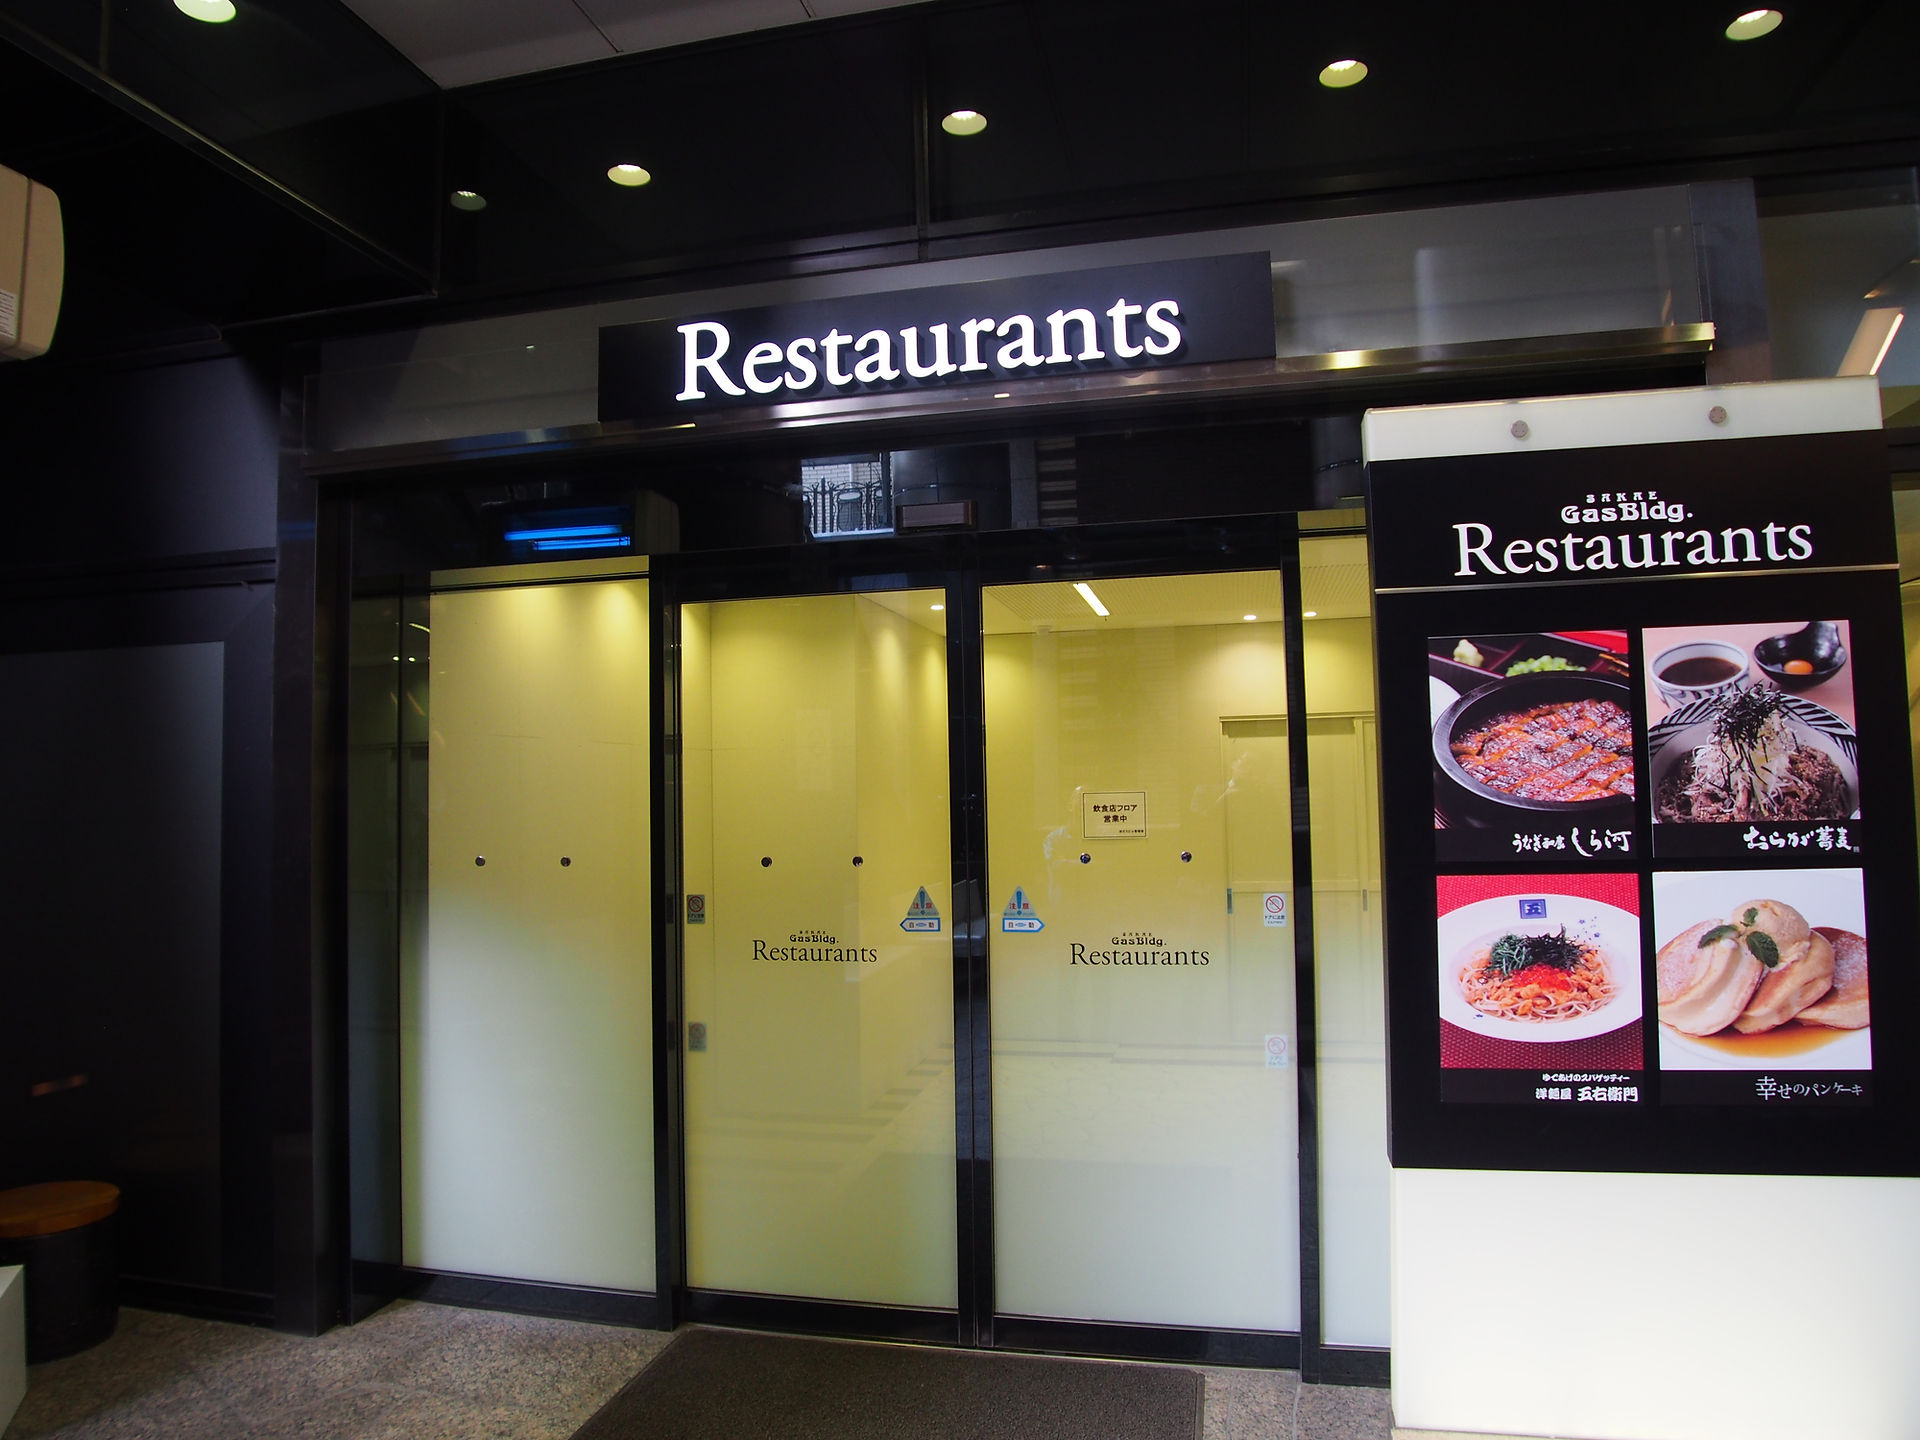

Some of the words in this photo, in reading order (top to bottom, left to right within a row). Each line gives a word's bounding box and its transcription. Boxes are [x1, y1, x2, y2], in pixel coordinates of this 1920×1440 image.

[676, 299, 1181, 402] Restaurants
[1586, 491, 1657, 504] SAKAE
[1453, 521, 1819, 578] Restaurants
[1092, 804, 1138, 813] 飲食店フロア
[1103, 814, 1128, 823] 営業中
[1571, 827, 1632, 857] しら河
[752, 939, 878, 963] Restaurants
[1069, 943, 1210, 966] Restaurants
[1577, 1086, 1639, 1102] 五右衛門
[1755, 1075, 1864, 1101] 幸せのパンケーキ
